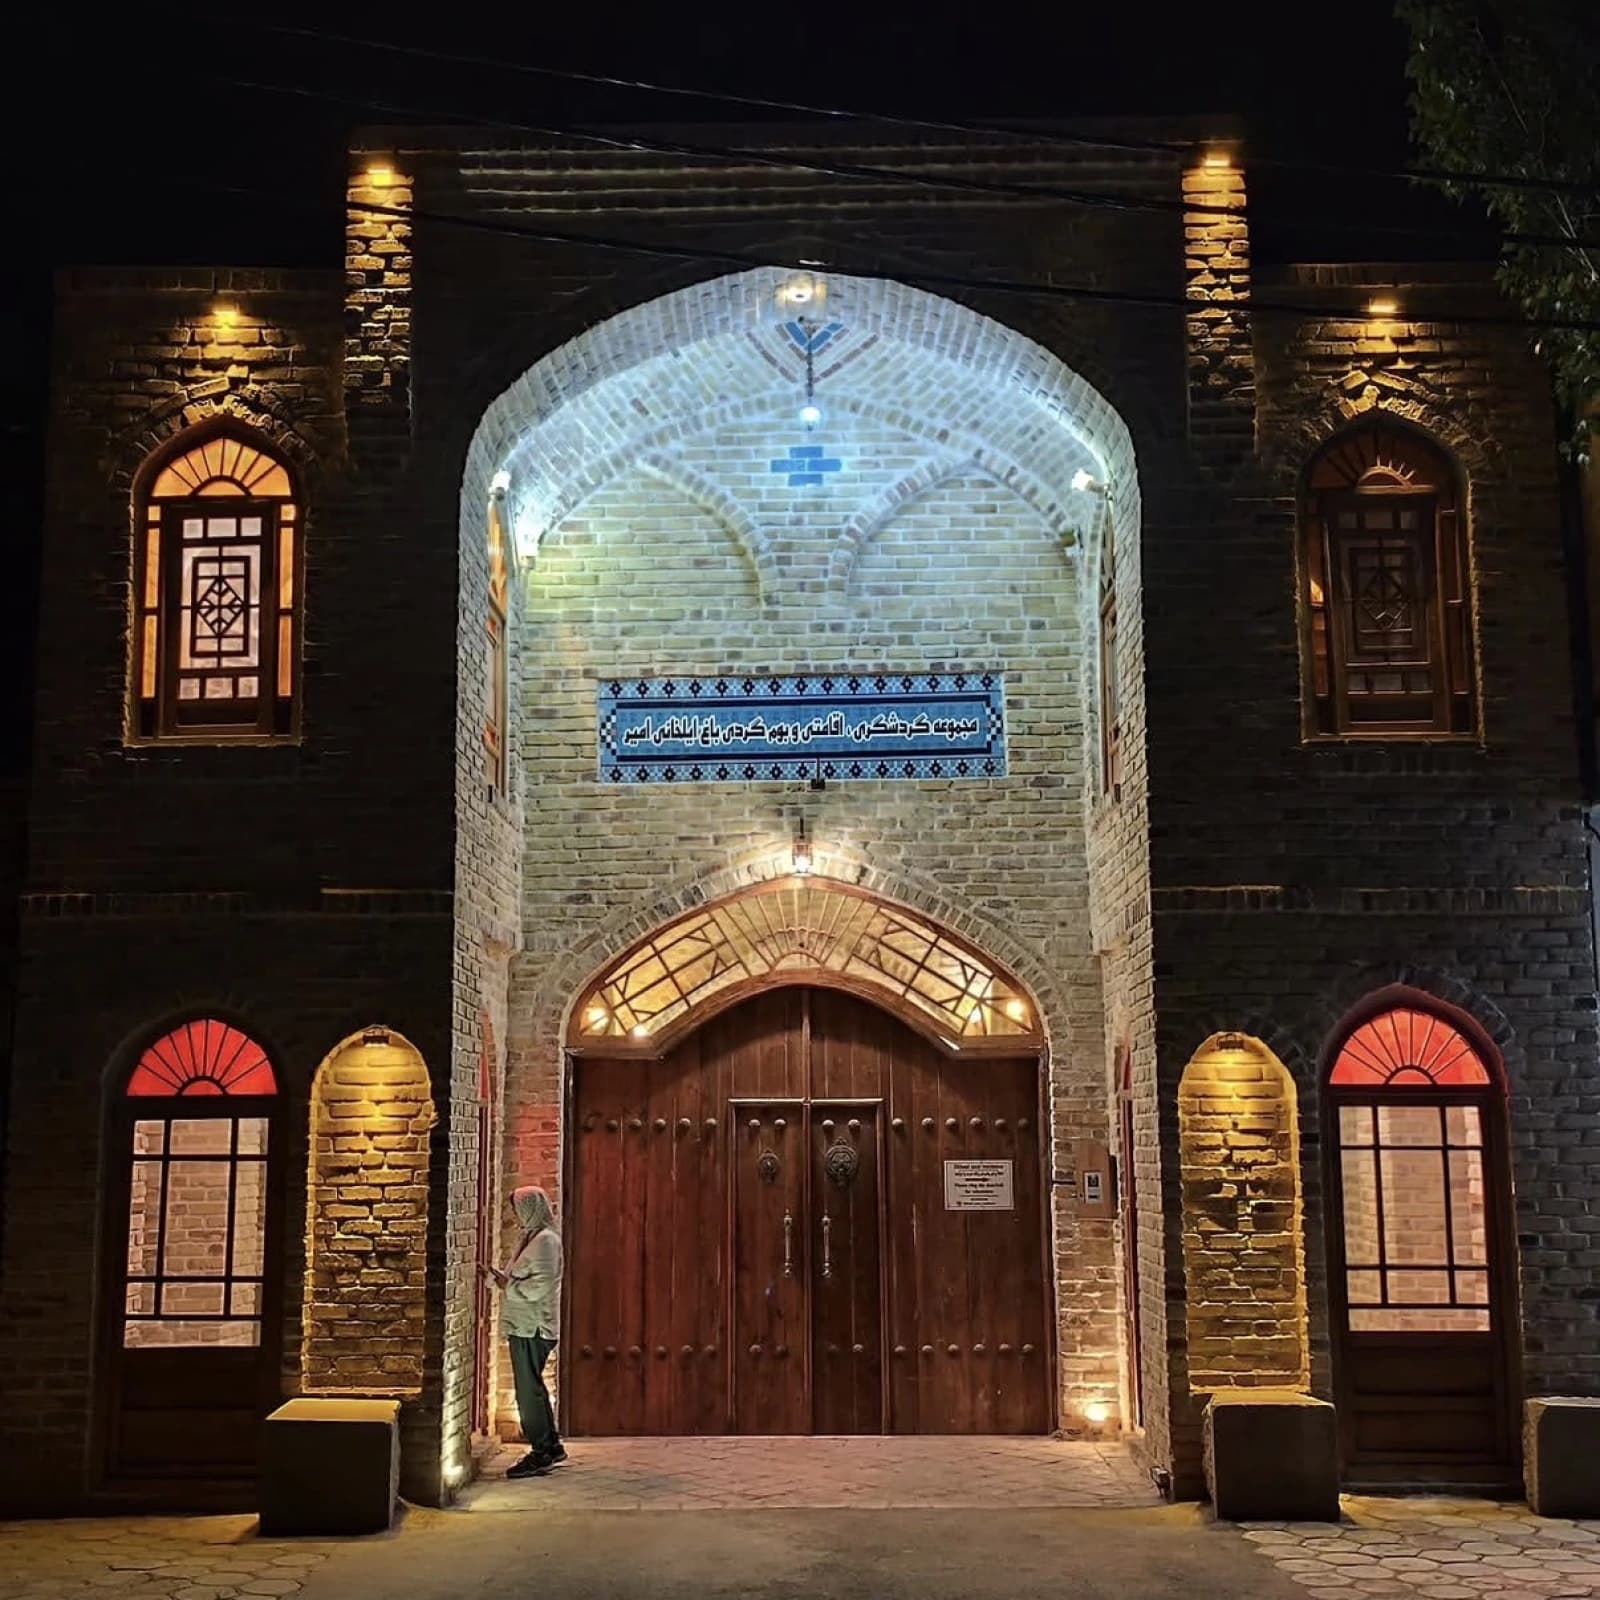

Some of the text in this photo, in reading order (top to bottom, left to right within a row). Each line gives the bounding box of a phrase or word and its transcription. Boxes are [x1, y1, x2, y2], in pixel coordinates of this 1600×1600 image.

[623, 716, 652, 748] امیر
[653, 715, 699, 747] ایلخانی
[699, 715, 720, 747] باغ
[791, 722, 801, 745] و
[801, 711, 845, 743] اقامتی
[933, 718, 979, 741] مجموعه
